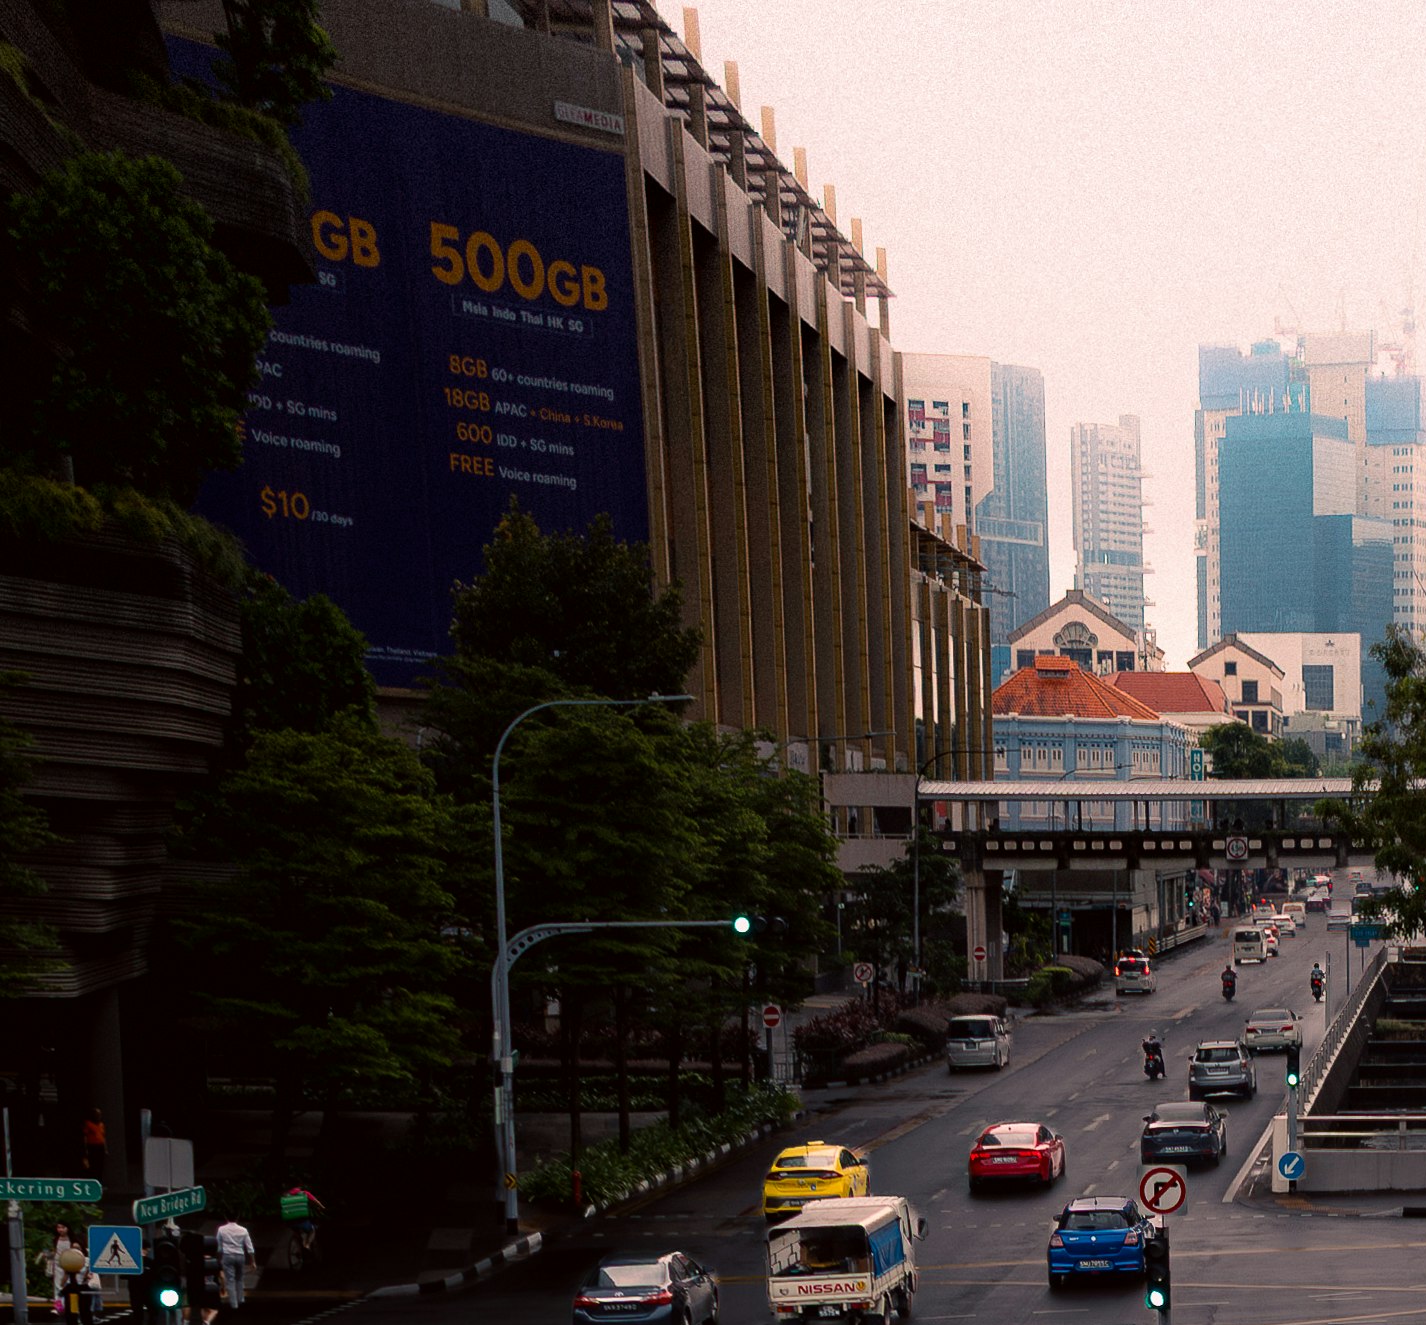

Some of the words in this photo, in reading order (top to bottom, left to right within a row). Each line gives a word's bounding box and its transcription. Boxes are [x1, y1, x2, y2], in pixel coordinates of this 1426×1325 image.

[429, 220, 609, 313] 500GB
[492, 303, 516, 321] Indo
[520, 309, 544, 327] Thai
[547, 315, 564, 330] HK
[568, 319, 585, 334] SG
[269, 329, 327, 354] countries
[330, 340, 381, 364] roaming
[448, 353, 489, 379] 8GB
[492, 367, 514, 384] 60+
[516, 373, 568, 392] countries
[569, 381, 614, 401] roaming
[286, 399, 306, 416] SG
[308, 405, 338, 422] mins
[443, 386, 490, 413] 18GB
[494, 400, 528, 418] APAC
[539, 407, 571, 426] China
[583, 414, 625, 433] S.Korea
[252, 428, 288, 447] Voice
[289, 437, 341, 459] roaming
[456, 420, 493, 446] 600
[496, 433, 517, 449] IDD
[530, 436, 548, 453] SG
[549, 440, 575, 456] mins
[450, 452, 495, 478] FREE
[498, 464, 530, 482] Voice
[532, 469, 577, 491] roaming
[260, 483, 311, 521] $10
[311, 510, 329, 522] /30
[329, 513, 354, 528] days
[73, 1182, 92, 1196] St
[140, 1201, 159, 1218] New
[160, 1196, 189, 1215] Bridge
[191, 1190, 202, 1206] Rd
[797, 1283, 856, 1295] NISSAN
